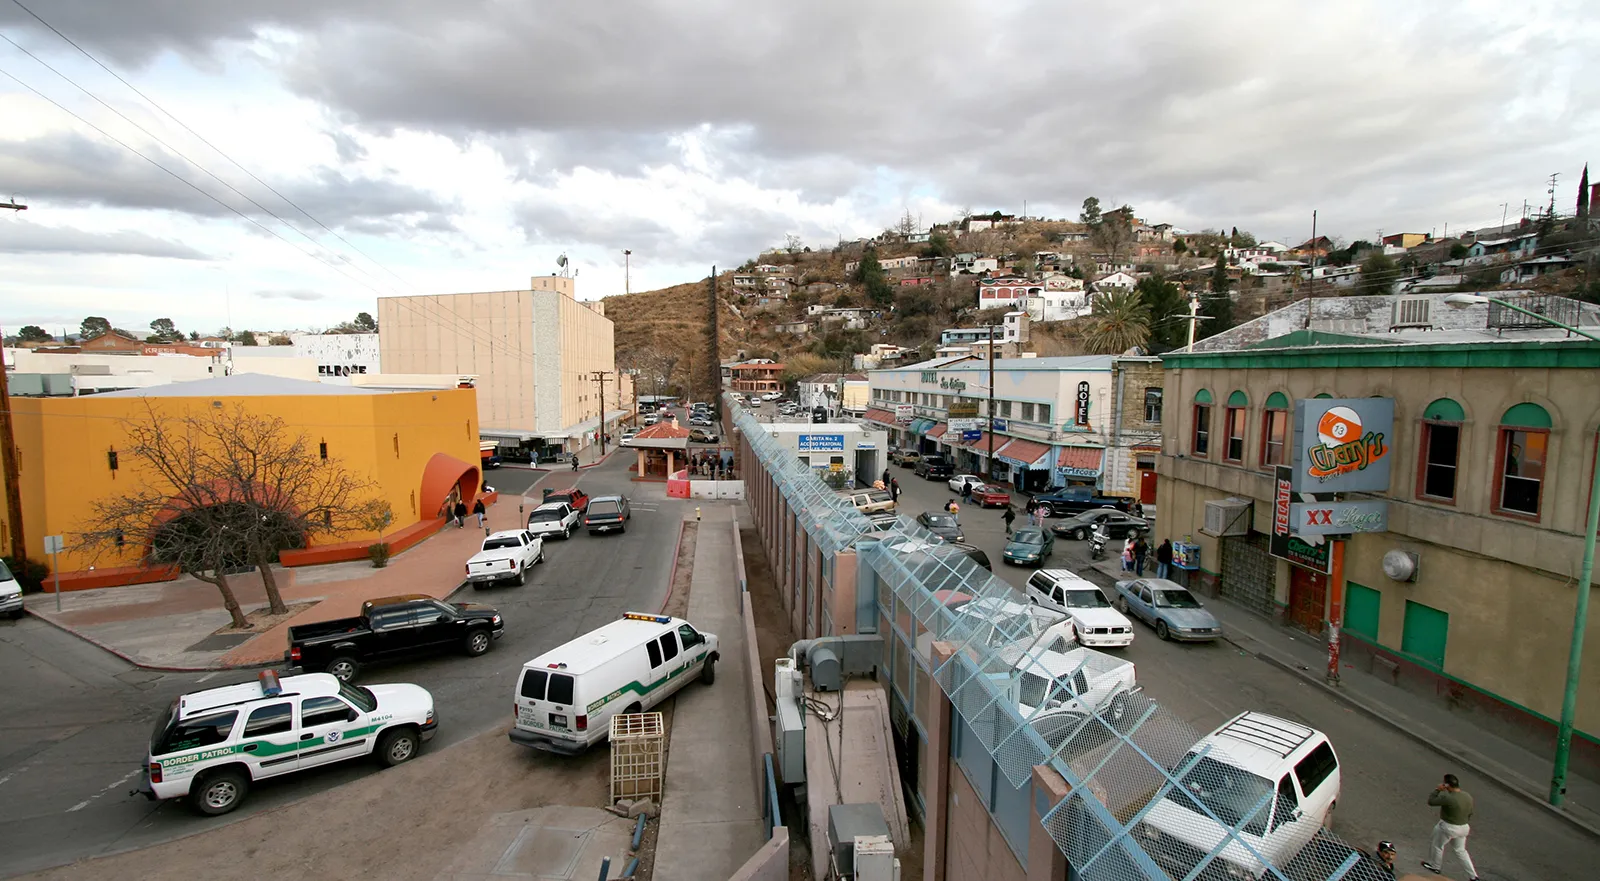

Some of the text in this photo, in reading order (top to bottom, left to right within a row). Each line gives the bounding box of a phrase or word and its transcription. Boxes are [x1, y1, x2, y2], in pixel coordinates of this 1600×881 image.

[1079, 384, 1089, 424] HOTEL
[1334, 425, 1345, 436] 13
[1308, 431, 1384, 471] Cherry's
[1275, 479, 1291, 536] TECATE
[1307, 509, 1334, 525] XX
[1287, 540, 1326, 560] Cherry's
[163, 747, 234, 767] BORDER PATROL
